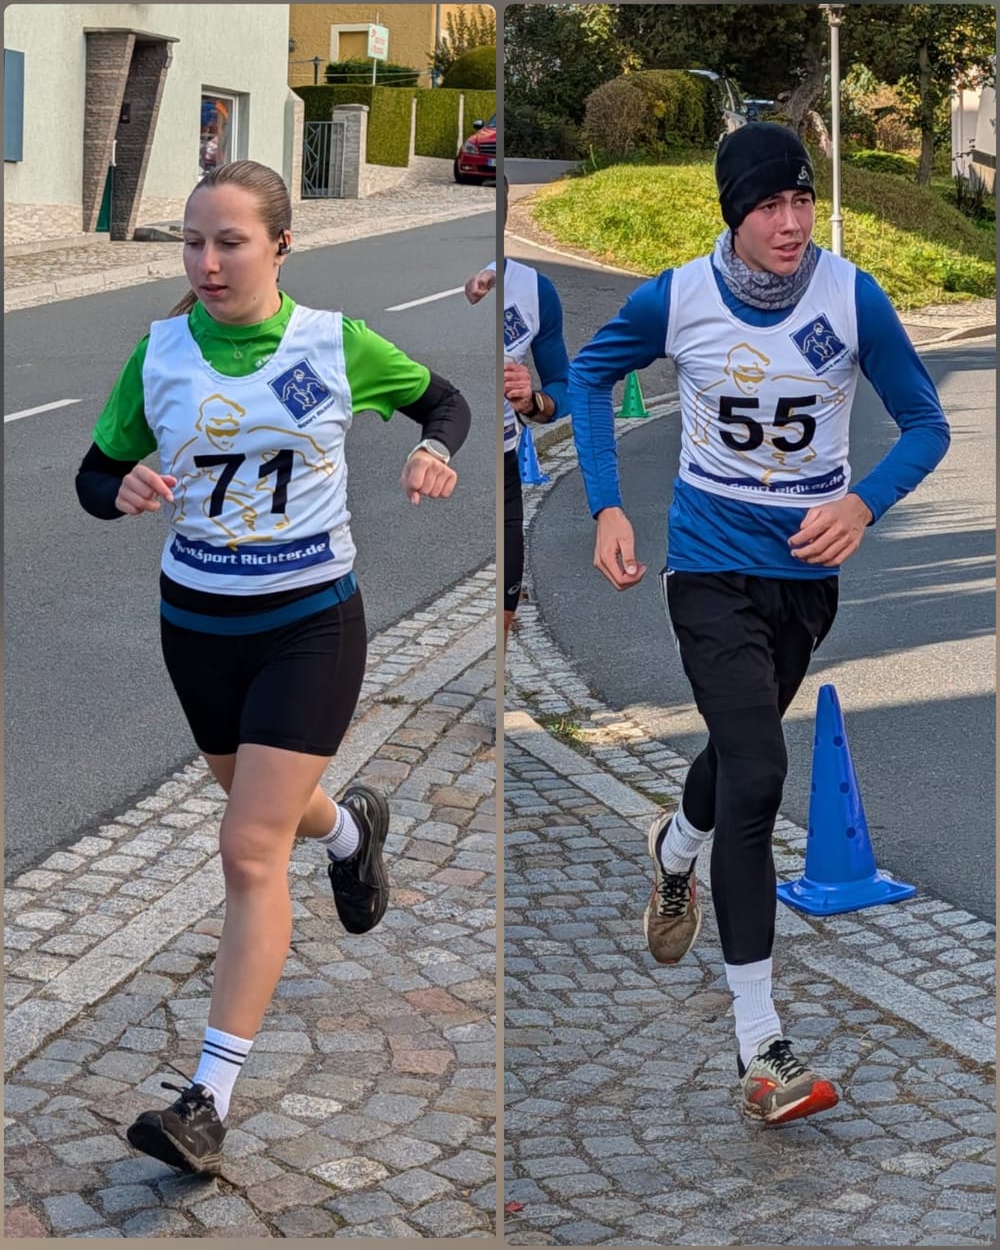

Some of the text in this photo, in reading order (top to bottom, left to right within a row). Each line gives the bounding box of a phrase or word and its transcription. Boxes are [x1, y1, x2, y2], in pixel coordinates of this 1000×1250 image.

[718, 394, 817, 453] 55
[193, 448, 294, 518] 71
[241, 542, 326, 565] Richter.de
